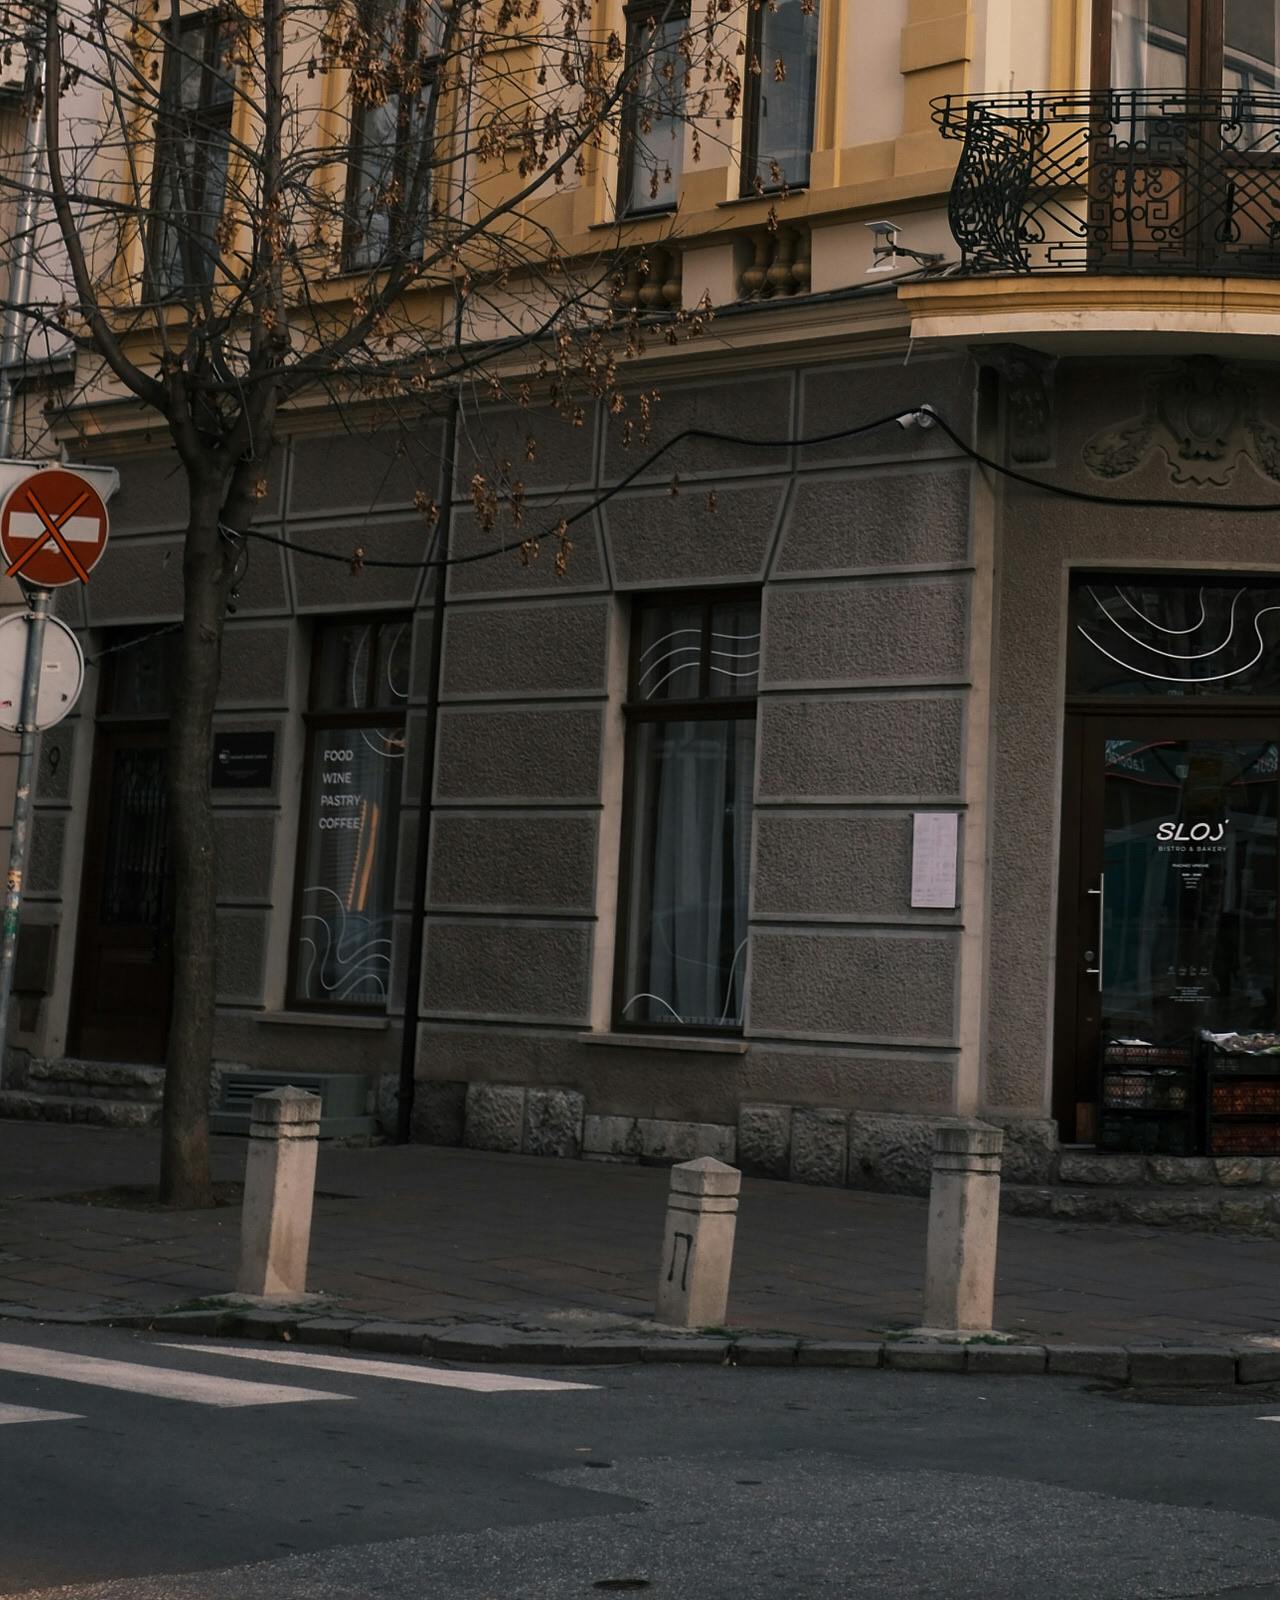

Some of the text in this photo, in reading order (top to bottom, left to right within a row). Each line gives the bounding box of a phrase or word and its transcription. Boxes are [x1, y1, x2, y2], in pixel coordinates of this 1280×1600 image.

[323, 750, 353, 762] FOOD
[322, 772, 352, 784] WINE
[320, 794, 361, 807] PASTRY
[318, 817, 360, 830] COFFEE
[1156, 819, 1230, 842] SLOJ
